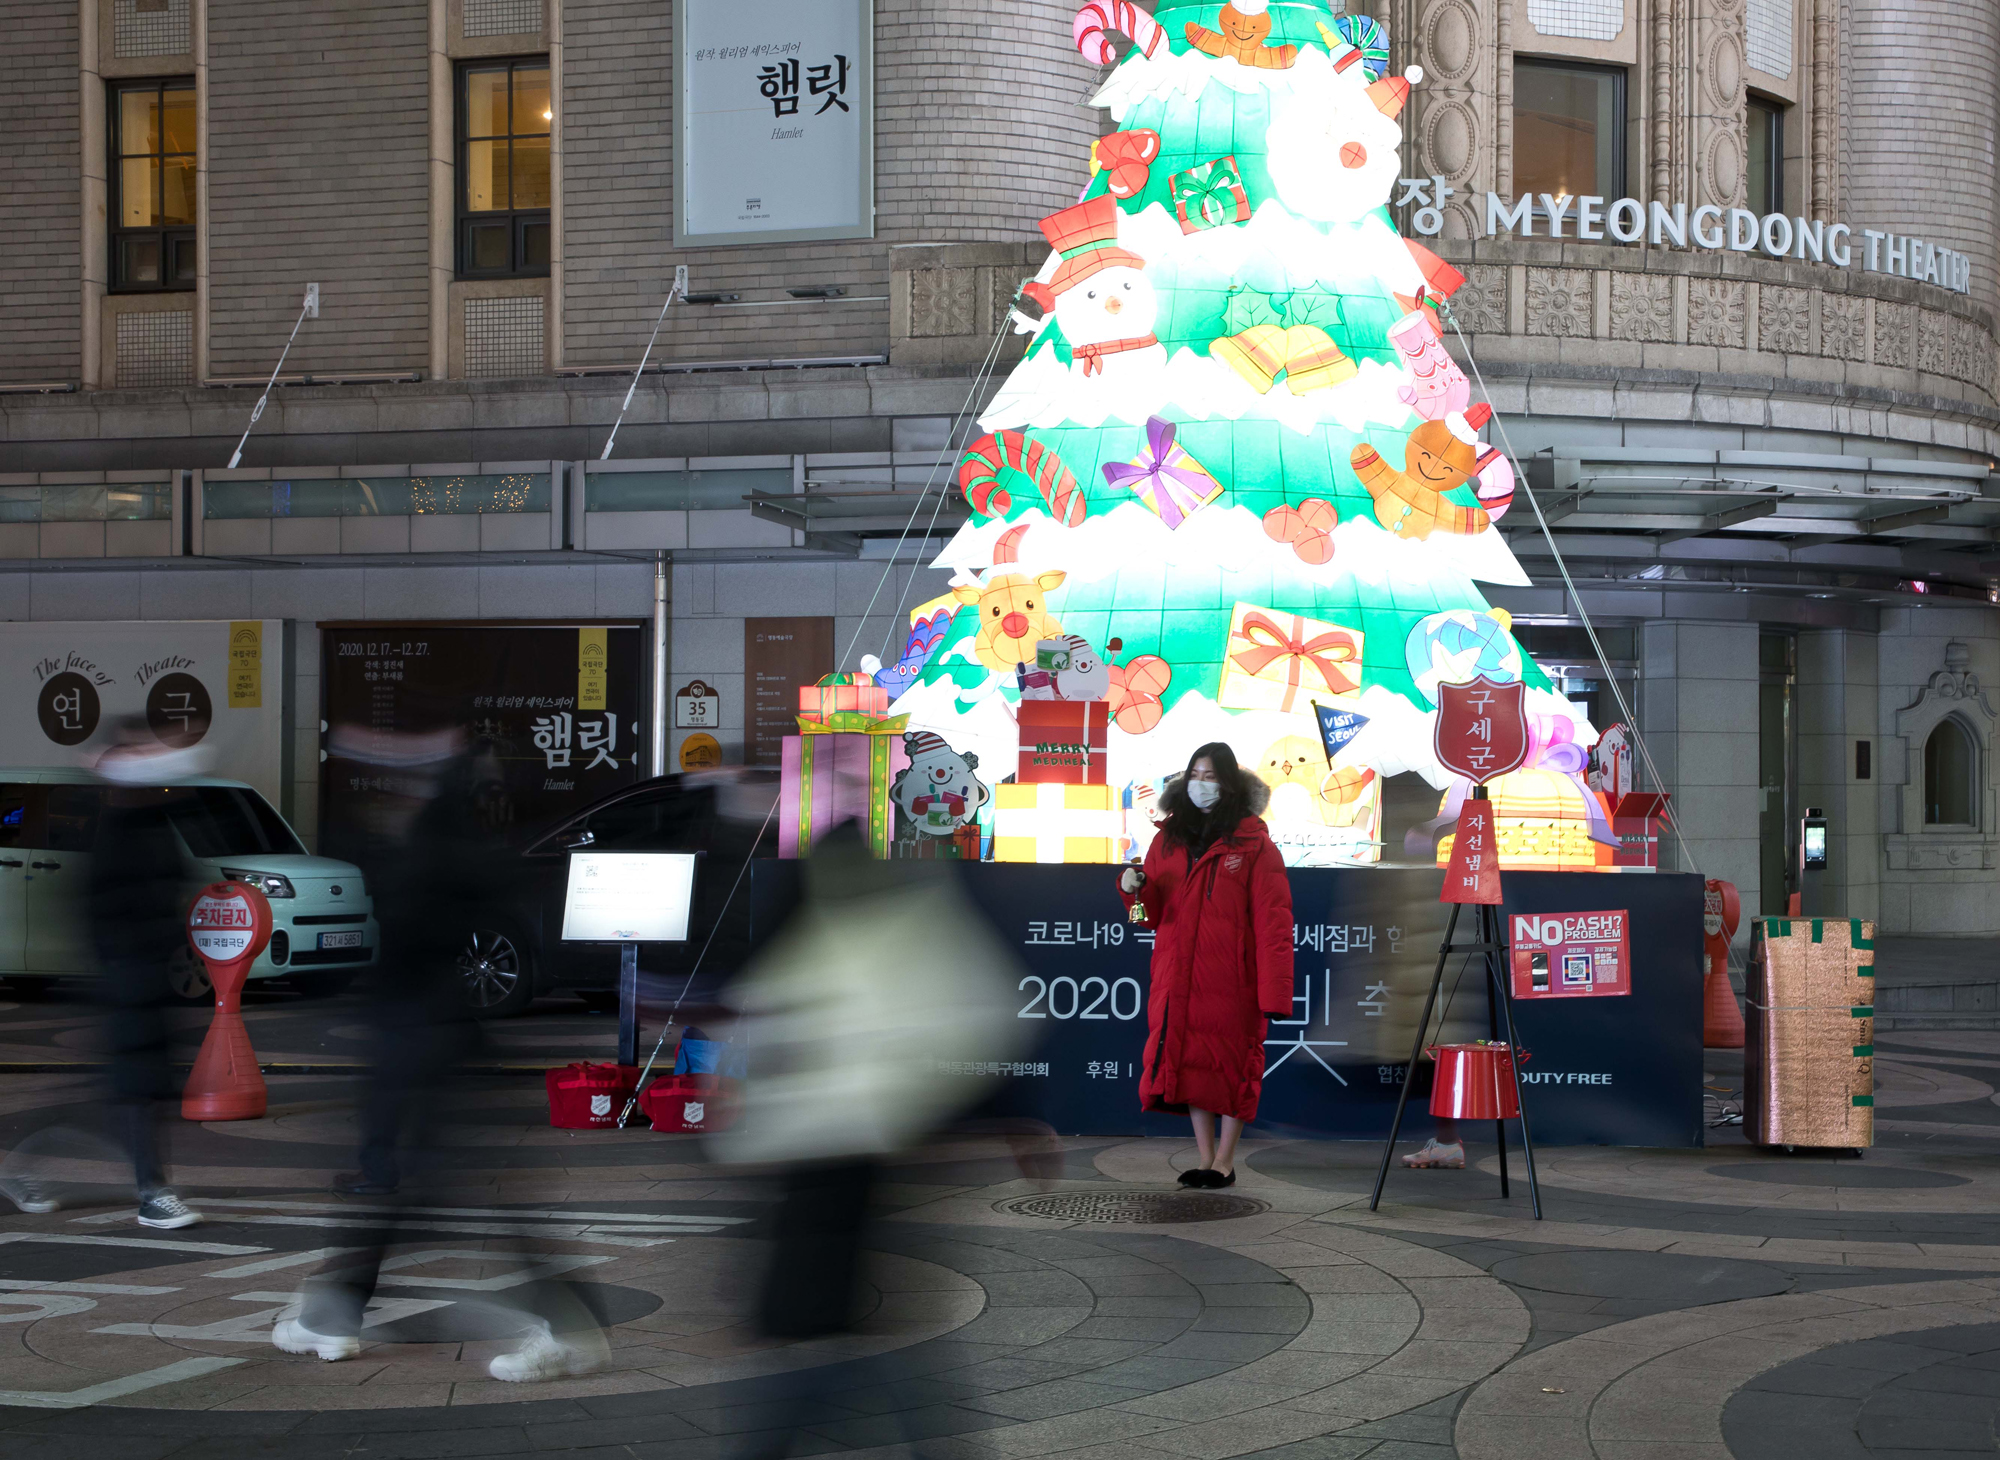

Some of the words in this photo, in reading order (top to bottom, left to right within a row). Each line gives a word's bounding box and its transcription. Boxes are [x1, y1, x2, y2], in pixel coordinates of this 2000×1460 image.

[718, 46, 748, 59] 윌리엄
[756, 54, 850, 118] 햄릿
[770, 127, 804, 140] Hamlet
[1486, 191, 1851, 267] MYEONGDONG
[1859, 229, 1972, 296] THEATER
[338, 642, 365, 656] 2020.
[367, 642, 379, 656] 12.
[415, 642, 430, 656] 27.
[32, 657, 61, 683] The
[64, 650, 97, 673] face
[93, 672, 117, 687] of
[134, 655, 196, 688] Theater
[240, 659, 249, 667] 70
[53, 688, 84, 730] 연
[160, 692, 197, 733] 극
[688, 701, 706, 716] 35
[1324, 713, 1354, 729] VISIT
[1466, 689, 1496, 770] 구세군
[530, 711, 618, 770] 햄릿
[1328, 725, 1361, 745] SEOUL
[1035, 742, 1092, 755] MERRY
[1032, 756, 1094, 767] MEDIHEAL
[543, 779, 575, 791] Hamlet
[1463, 814, 1486, 892] 자선냄비
[197, 908, 247, 926] 주차금지
[1025, 921, 1124, 949] 코로나19
[1516, 916, 1564, 946] NO
[1563, 915, 1622, 931] CASH?
[1564, 929, 1621, 940] PROBLEM
[213, 938, 245, 947] 국립극단
[1017, 975, 1141, 1020] 2020
[1086, 1060, 1118, 1079] 후원
[1567, 1073, 1612, 1085] FREE
